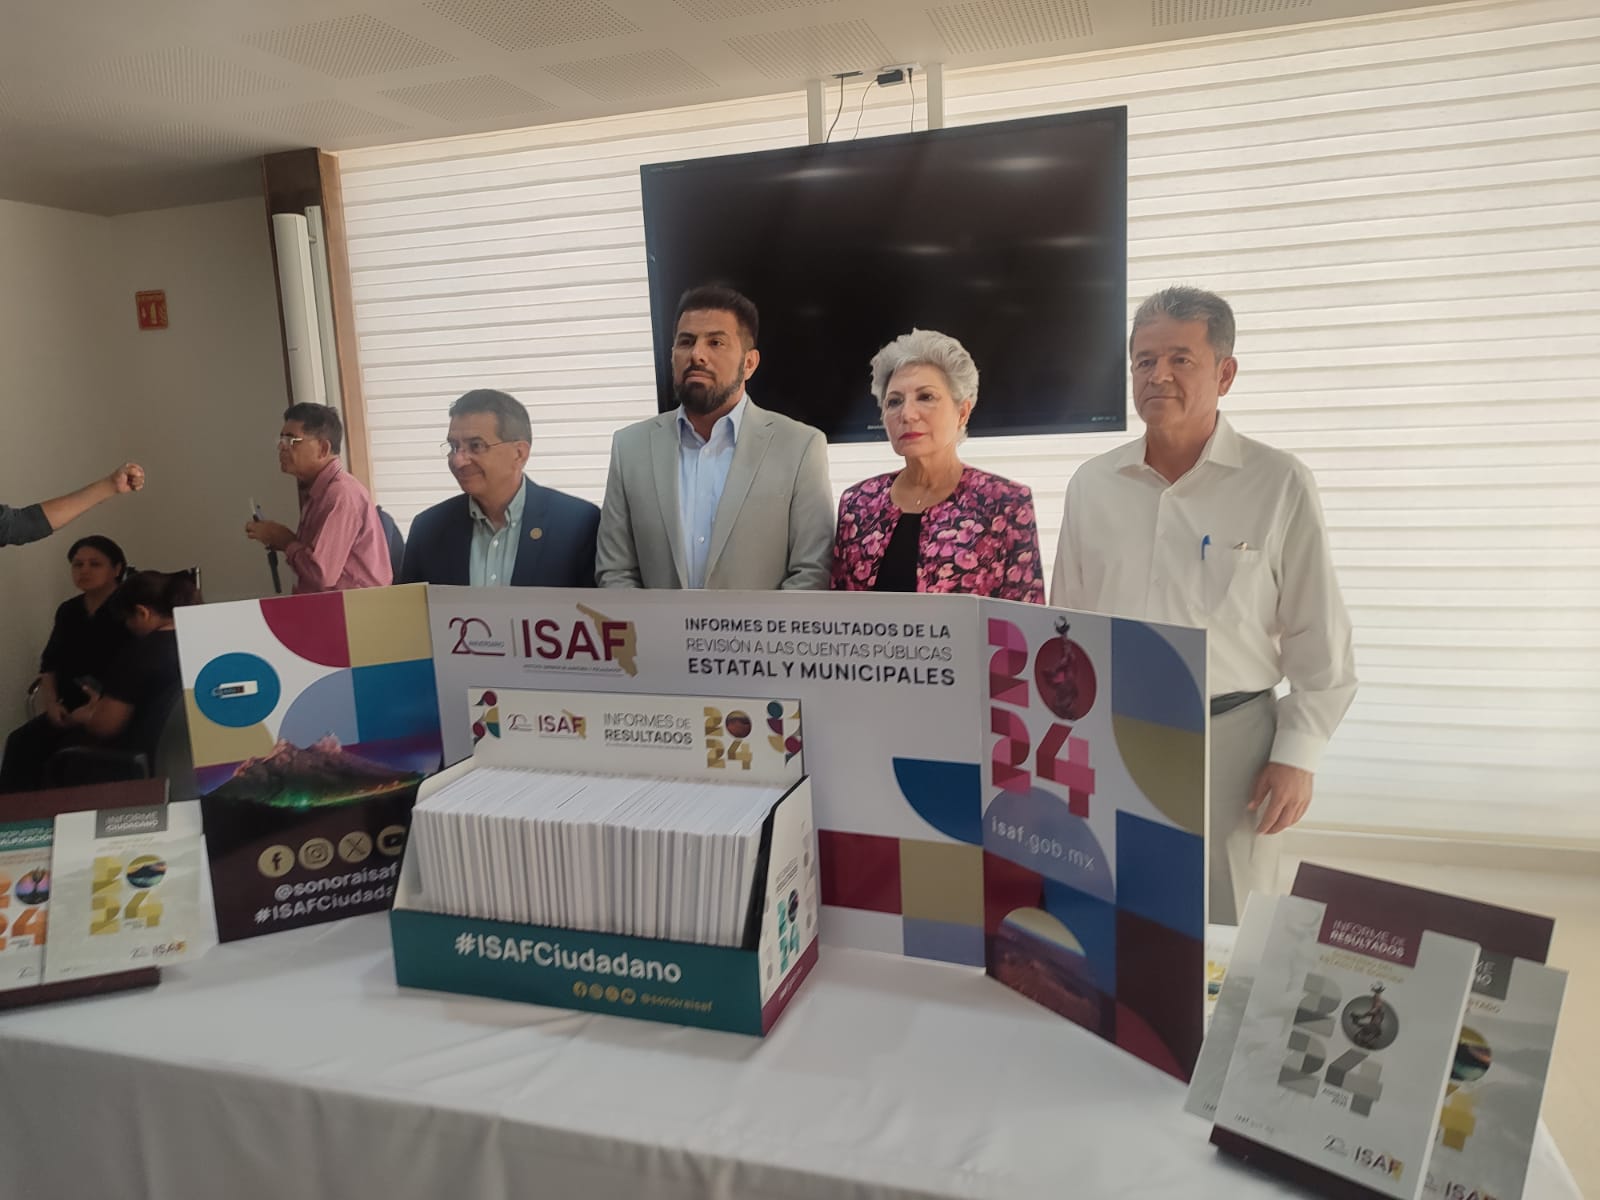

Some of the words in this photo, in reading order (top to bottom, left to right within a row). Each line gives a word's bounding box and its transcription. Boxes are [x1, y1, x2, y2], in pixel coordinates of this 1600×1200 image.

[522, 619, 627, 661] ISAF
[684, 617, 762, 634] INFORMES
[767, 619, 787, 634] DE
[791, 620, 898, 638] RESULTADOS
[903, 623, 925, 638] DE
[930, 624, 951, 639] LA
[686, 636, 751, 654] REVISIÓN
[753, 639, 765, 654] A
[767, 639, 794, 656] LAS
[796, 640, 870, 659] CUENTAS
[873, 641, 953, 662] PÚBLICAS
[688, 657, 778, 678] ESTATAL
[782, 661, 794, 678] Y
[800, 661, 956, 686] MUNICIPALES
[538, 714, 585, 733] ISAF
[604, 712, 674, 729] INFORMES
[675, 717, 692, 730] DE
[604, 728, 693, 745] RESULTADOS
[991, 815, 1095, 872] isaf.gob.mx
[274, 861, 398, 901] @sonoraisaf
[1329, 929, 1405, 959] RESULTADOS
[1332, 919, 1390, 943] INFORME
[455, 931, 682, 984] #ISAFCiudadano
[1355, 1146, 1403, 1175] ISAF
